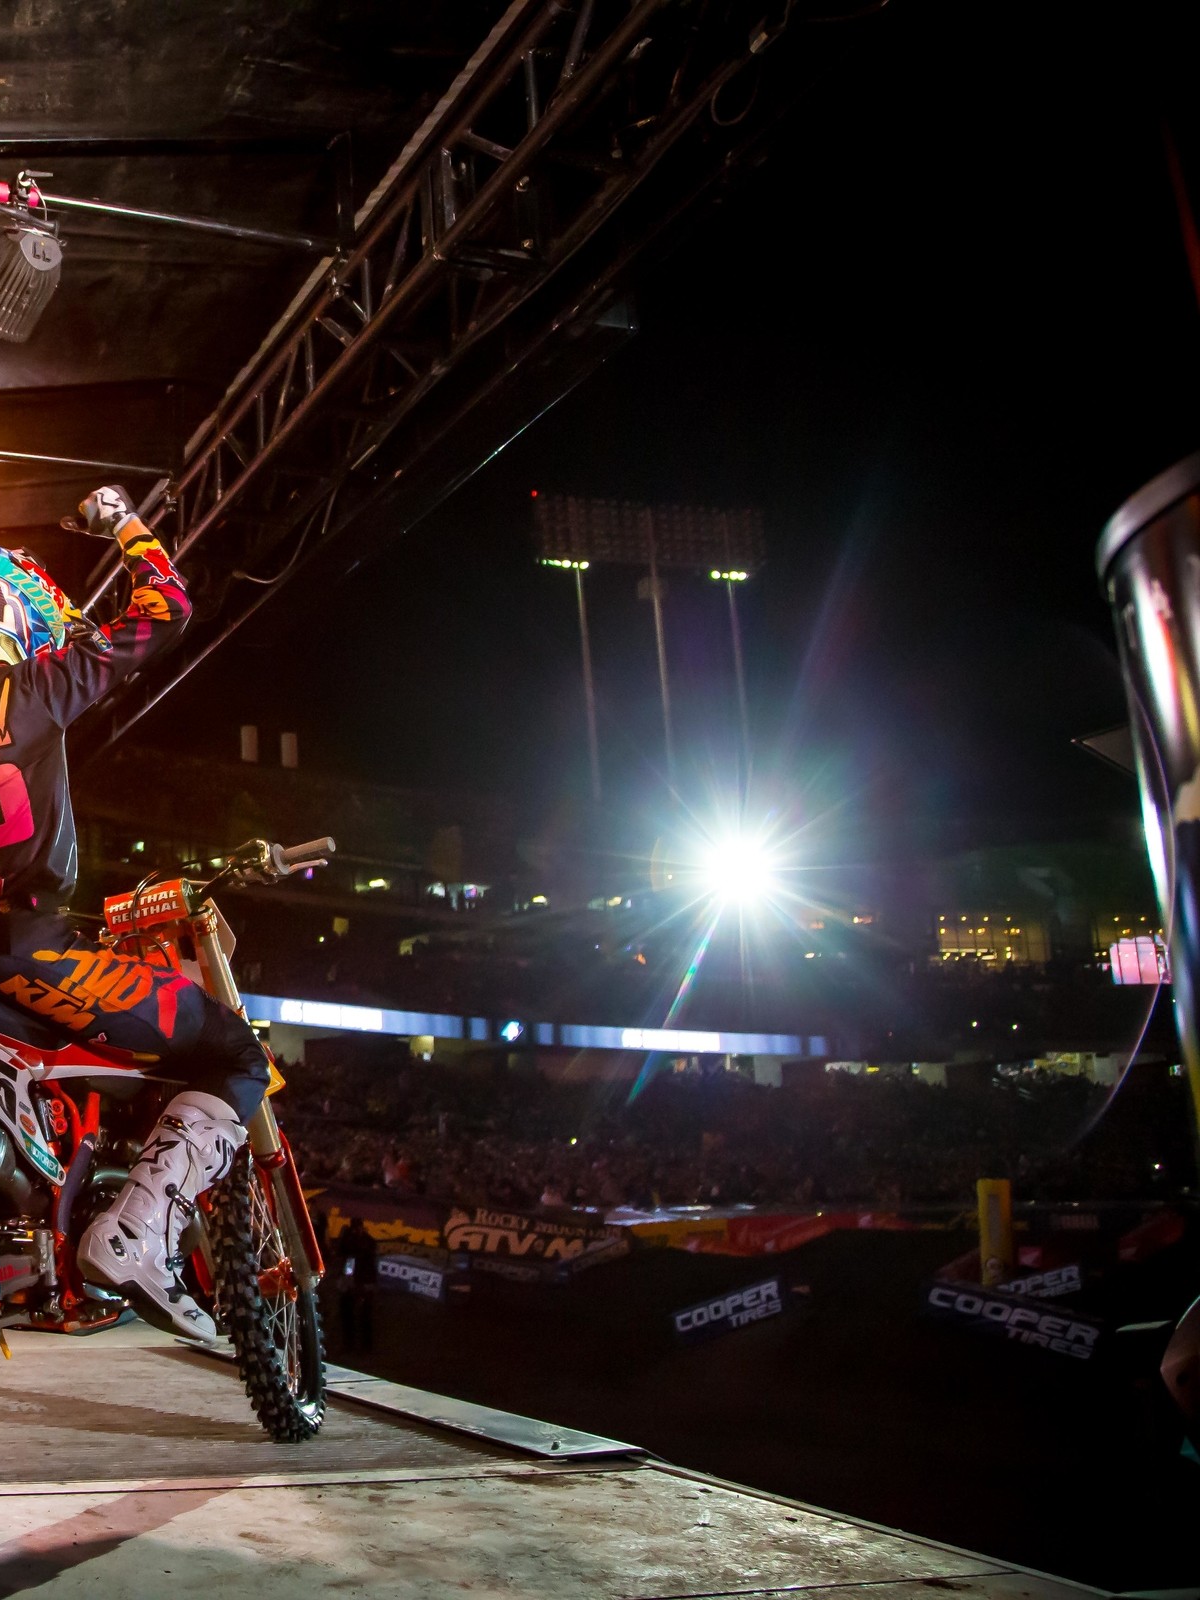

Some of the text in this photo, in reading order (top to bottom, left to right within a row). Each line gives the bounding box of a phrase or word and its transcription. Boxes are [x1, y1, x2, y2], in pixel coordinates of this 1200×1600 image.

[474, 1206, 530, 1231] ROCKY
[997, 1264, 1081, 1297] OPER
[675, 1280, 779, 1332] COOPER
[728, 1299, 782, 1328] TIRES
[928, 1286, 1101, 1346] COOPER
[1005, 1325, 1095, 1360] TIRES
